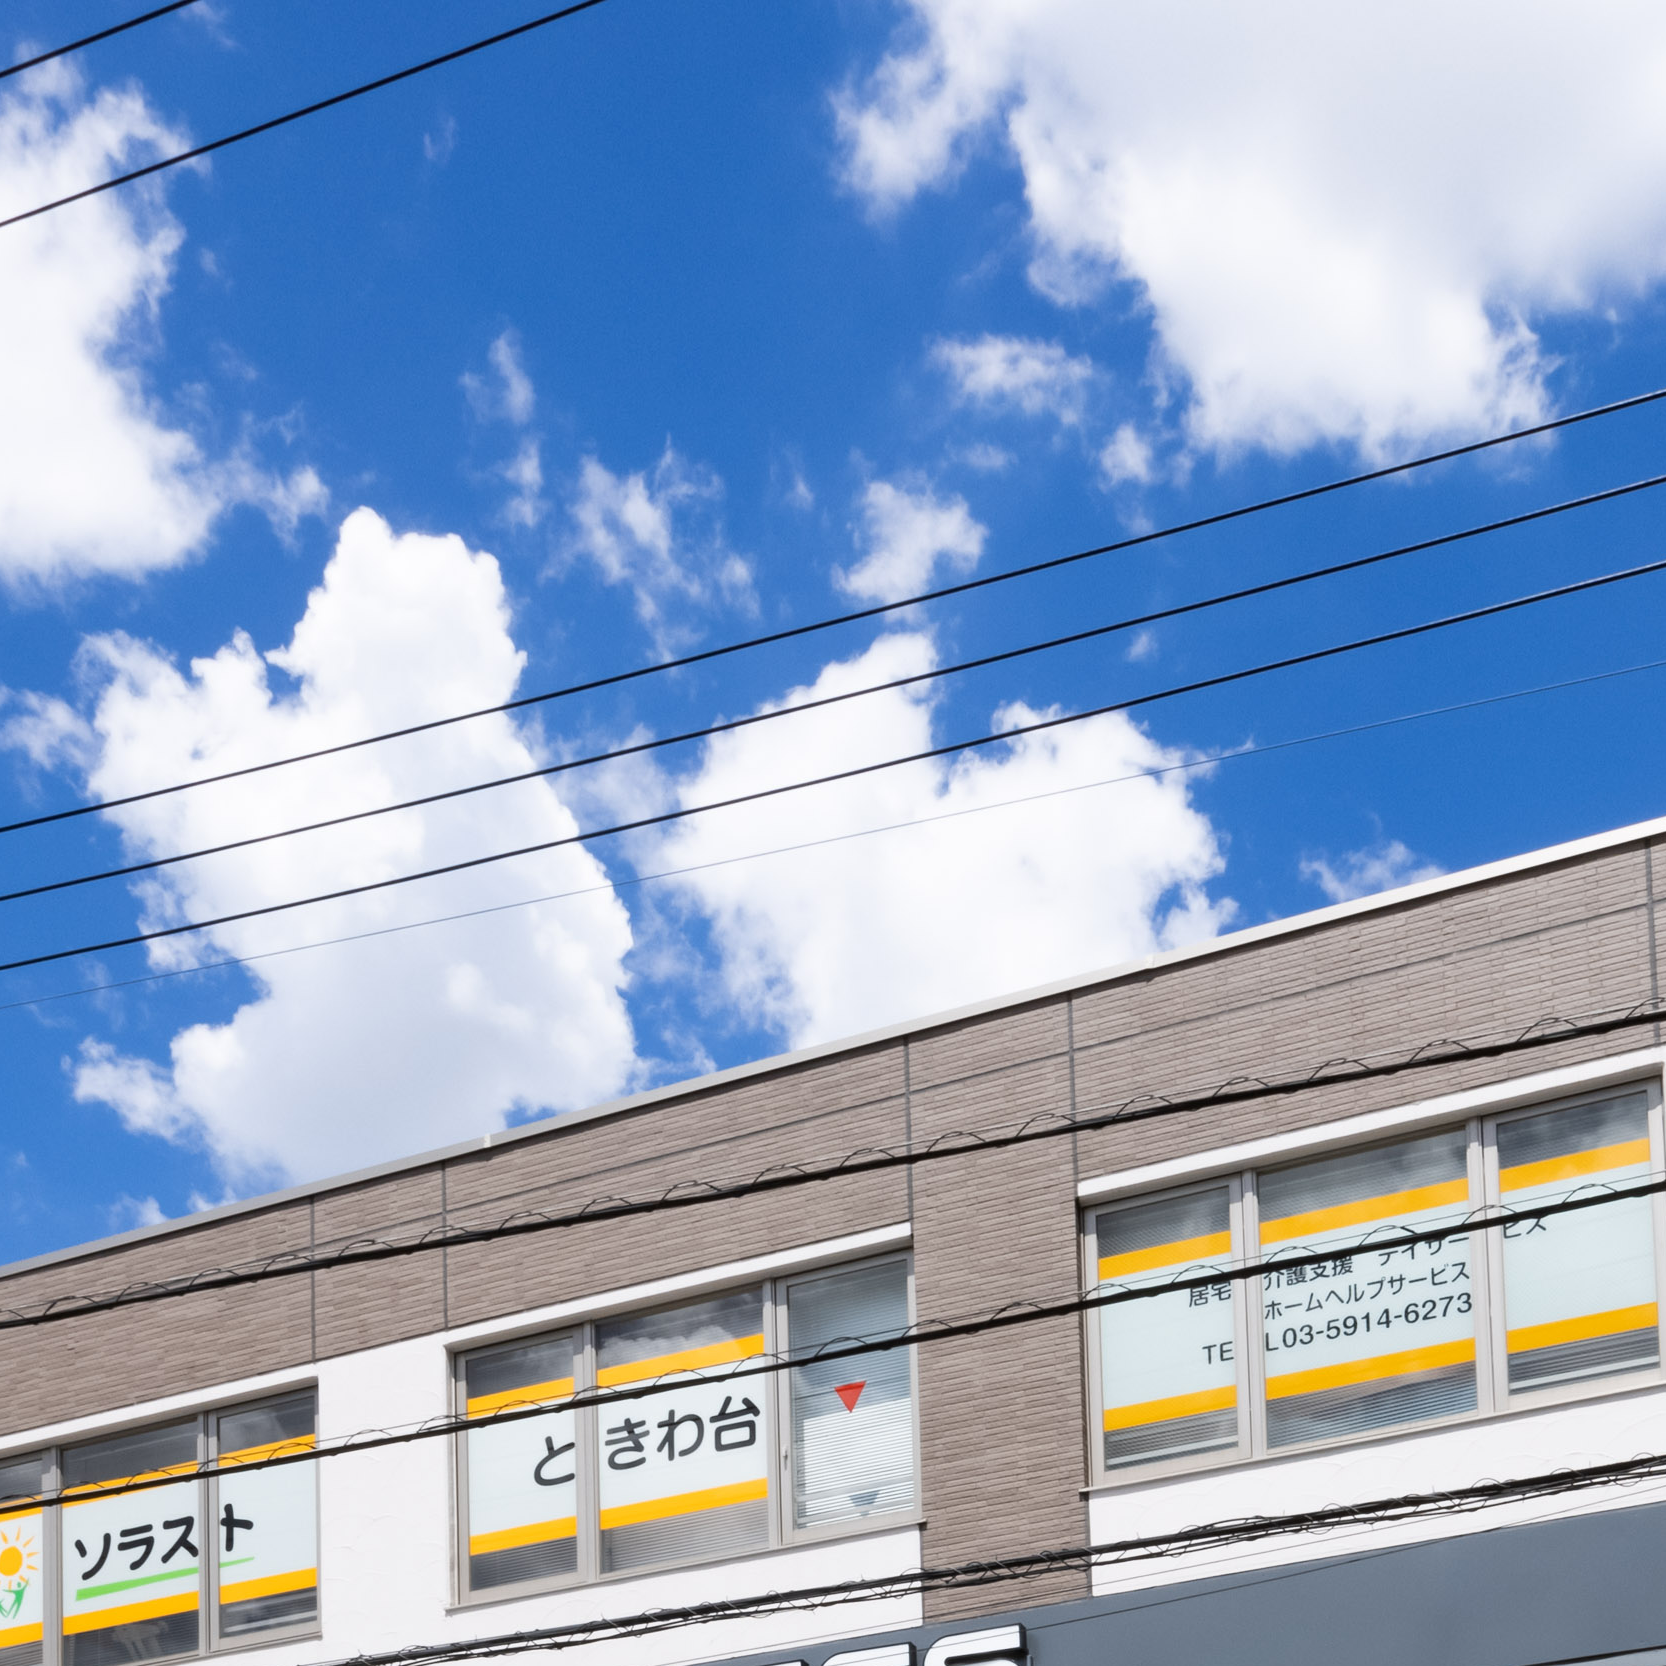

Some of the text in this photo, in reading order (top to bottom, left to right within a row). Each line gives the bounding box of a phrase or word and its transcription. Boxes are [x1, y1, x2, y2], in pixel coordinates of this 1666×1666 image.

[1264, 1261, 1470, 1321] ホームヘルプサービス
[533, 1396, 760, 1486] ときわ台
[75, 1503, 254, 1580] ソラスト
